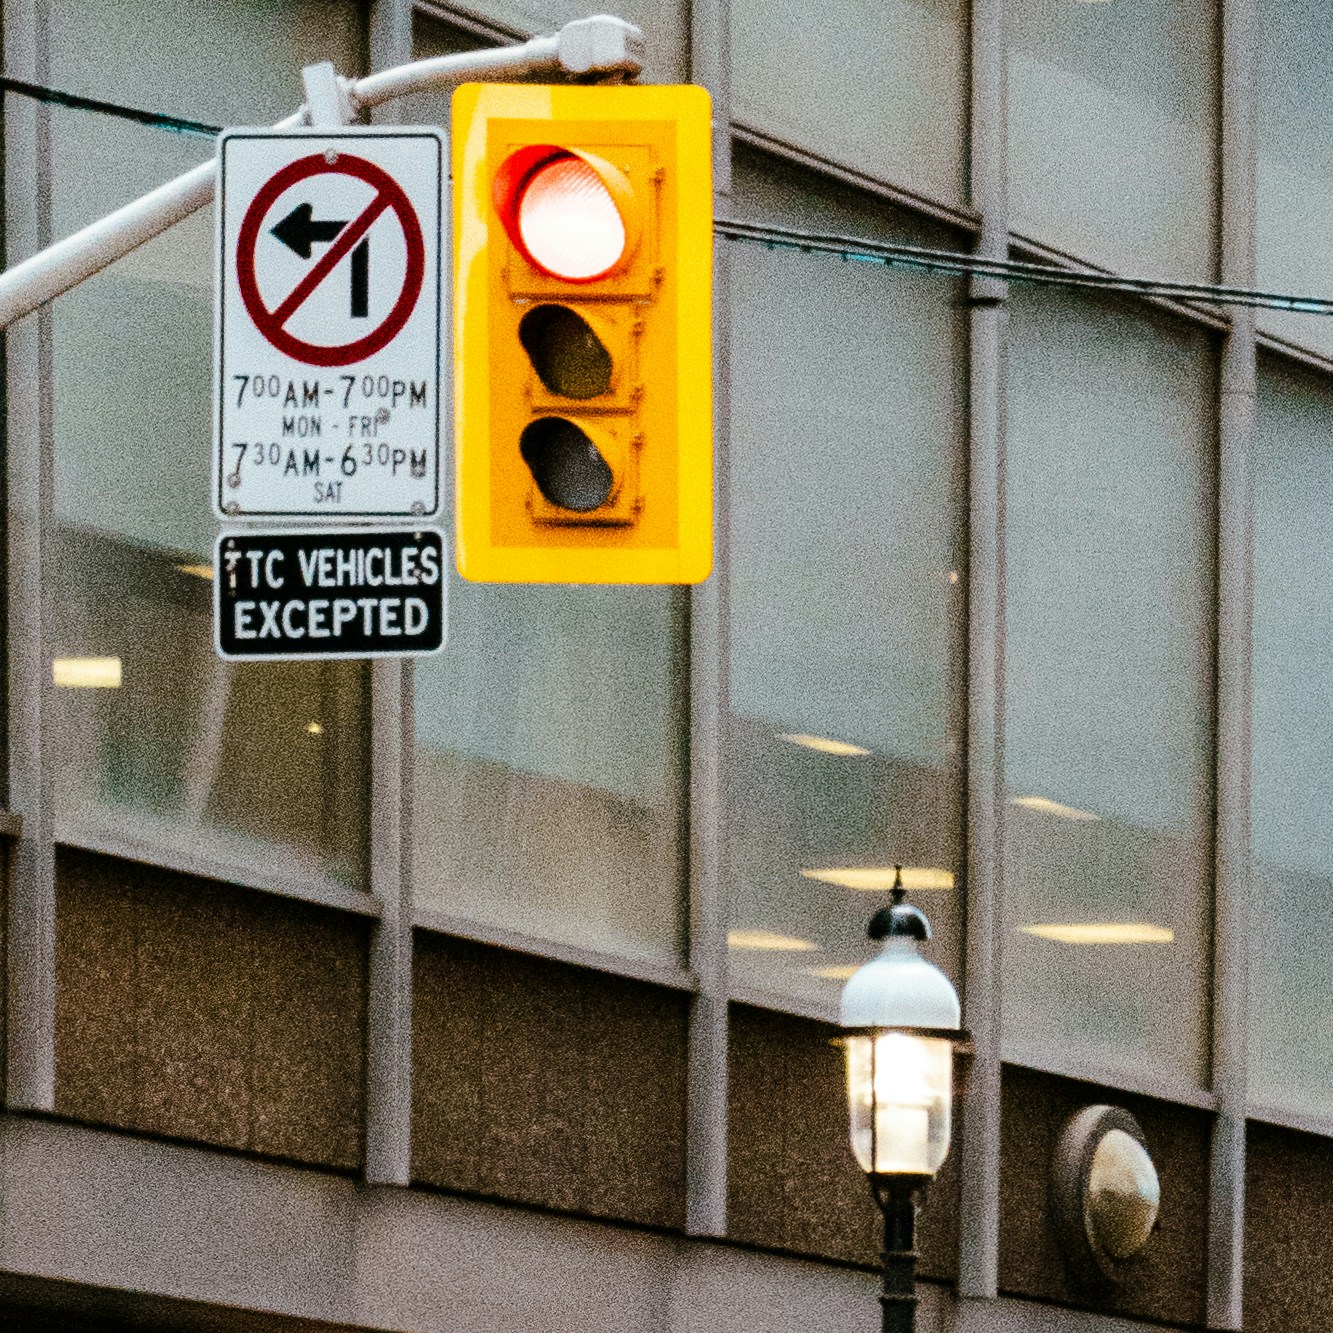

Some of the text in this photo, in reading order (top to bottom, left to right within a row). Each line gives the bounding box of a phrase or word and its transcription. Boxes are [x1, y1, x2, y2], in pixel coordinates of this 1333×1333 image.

[282, 415, 321, 437] MON
[349, 415, 380, 438] FRI
[314, 481, 343, 503] SAT
[225, 546, 440, 590] TTC VEHICLES
[234, 597, 429, 640] EXCEPTED
